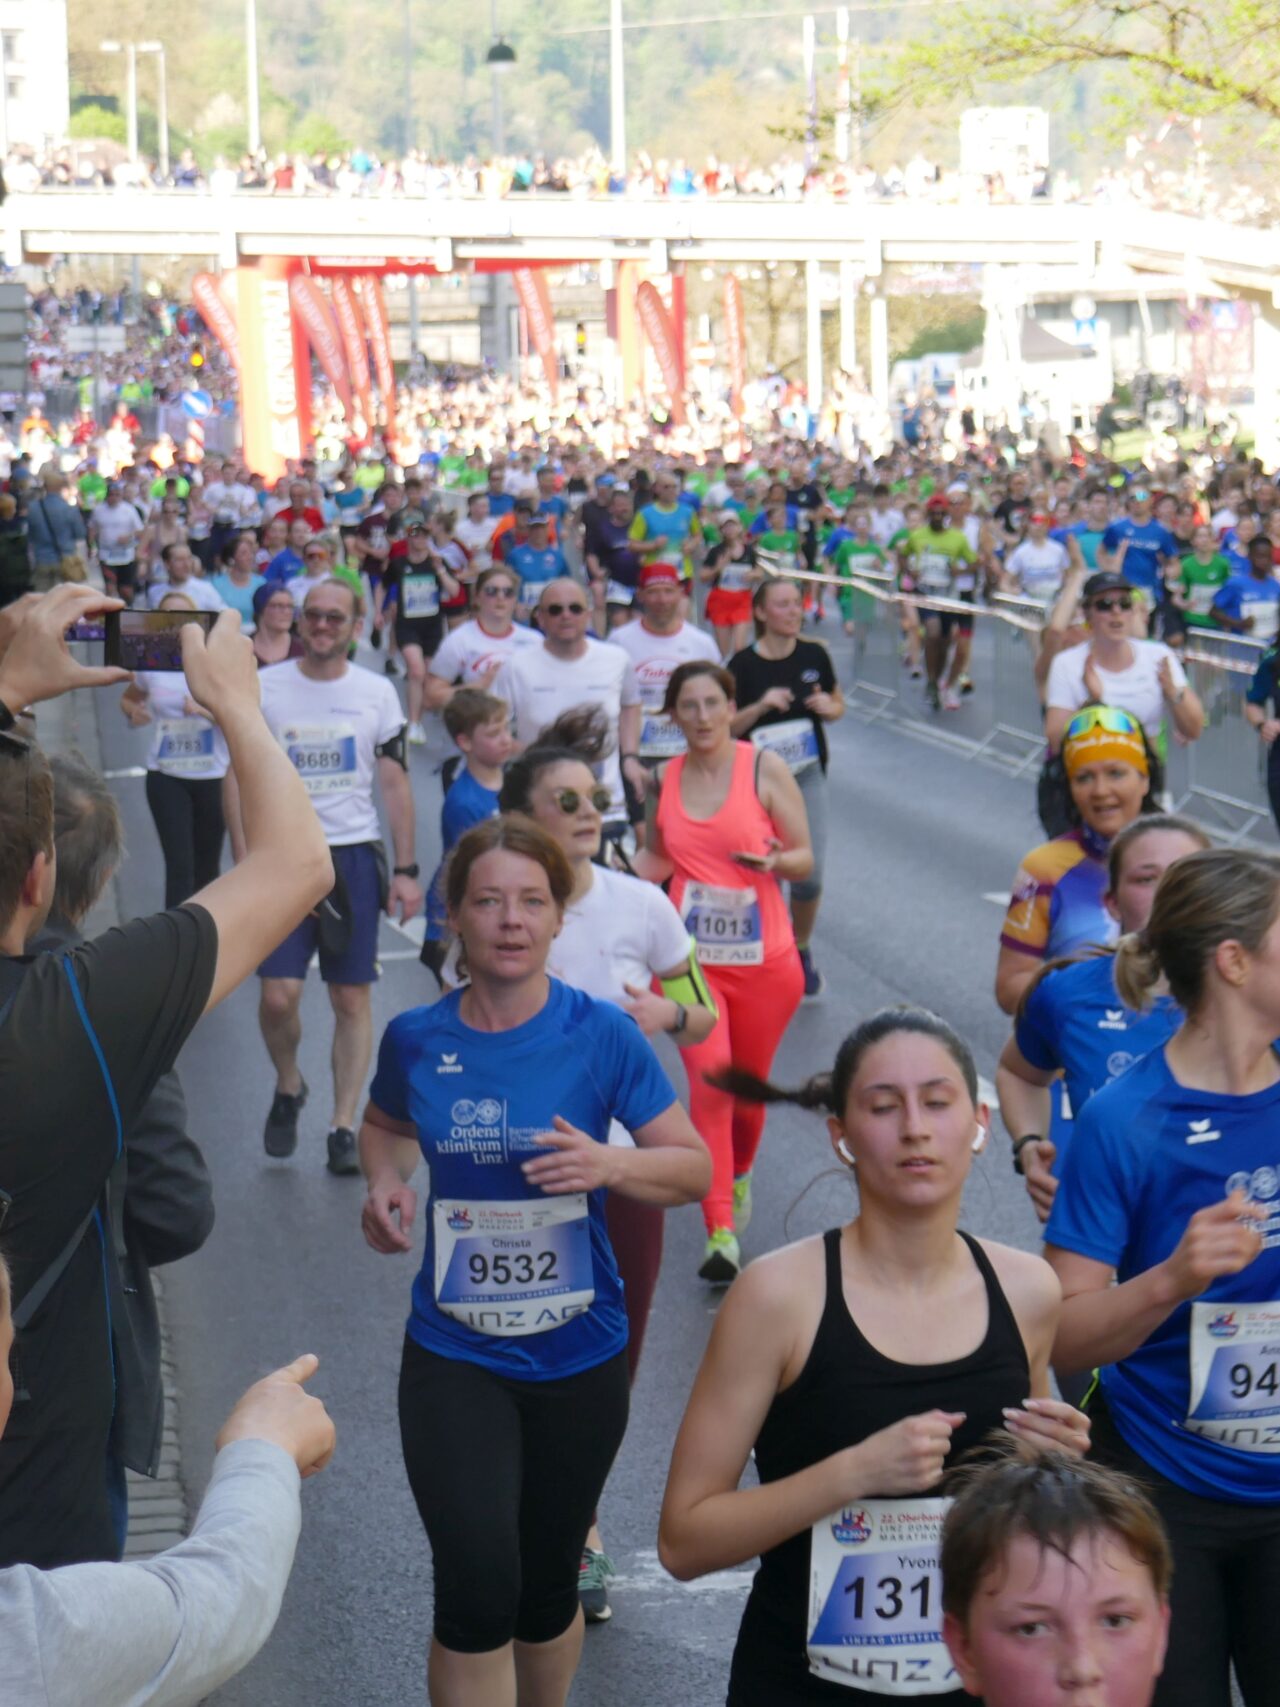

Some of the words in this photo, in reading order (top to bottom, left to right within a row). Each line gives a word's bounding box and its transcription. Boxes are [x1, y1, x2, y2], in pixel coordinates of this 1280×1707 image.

[296, 751, 342, 769] 8689
[451, 1124, 500, 1139] Ordens
[436, 1139, 501, 1154] klinikum
[473, 1152, 503, 1165] Linz
[492, 1238, 531, 1249] Christa
[468, 1251, 559, 1285] 9532
[450, 1310, 527, 1328] INZ
[881, 1515, 897, 1524] 22.
[879, 1533, 938, 1542] MARATHO
[844, 1575, 931, 1620] 131
[891, 1632, 942, 1643] VIERTEL
